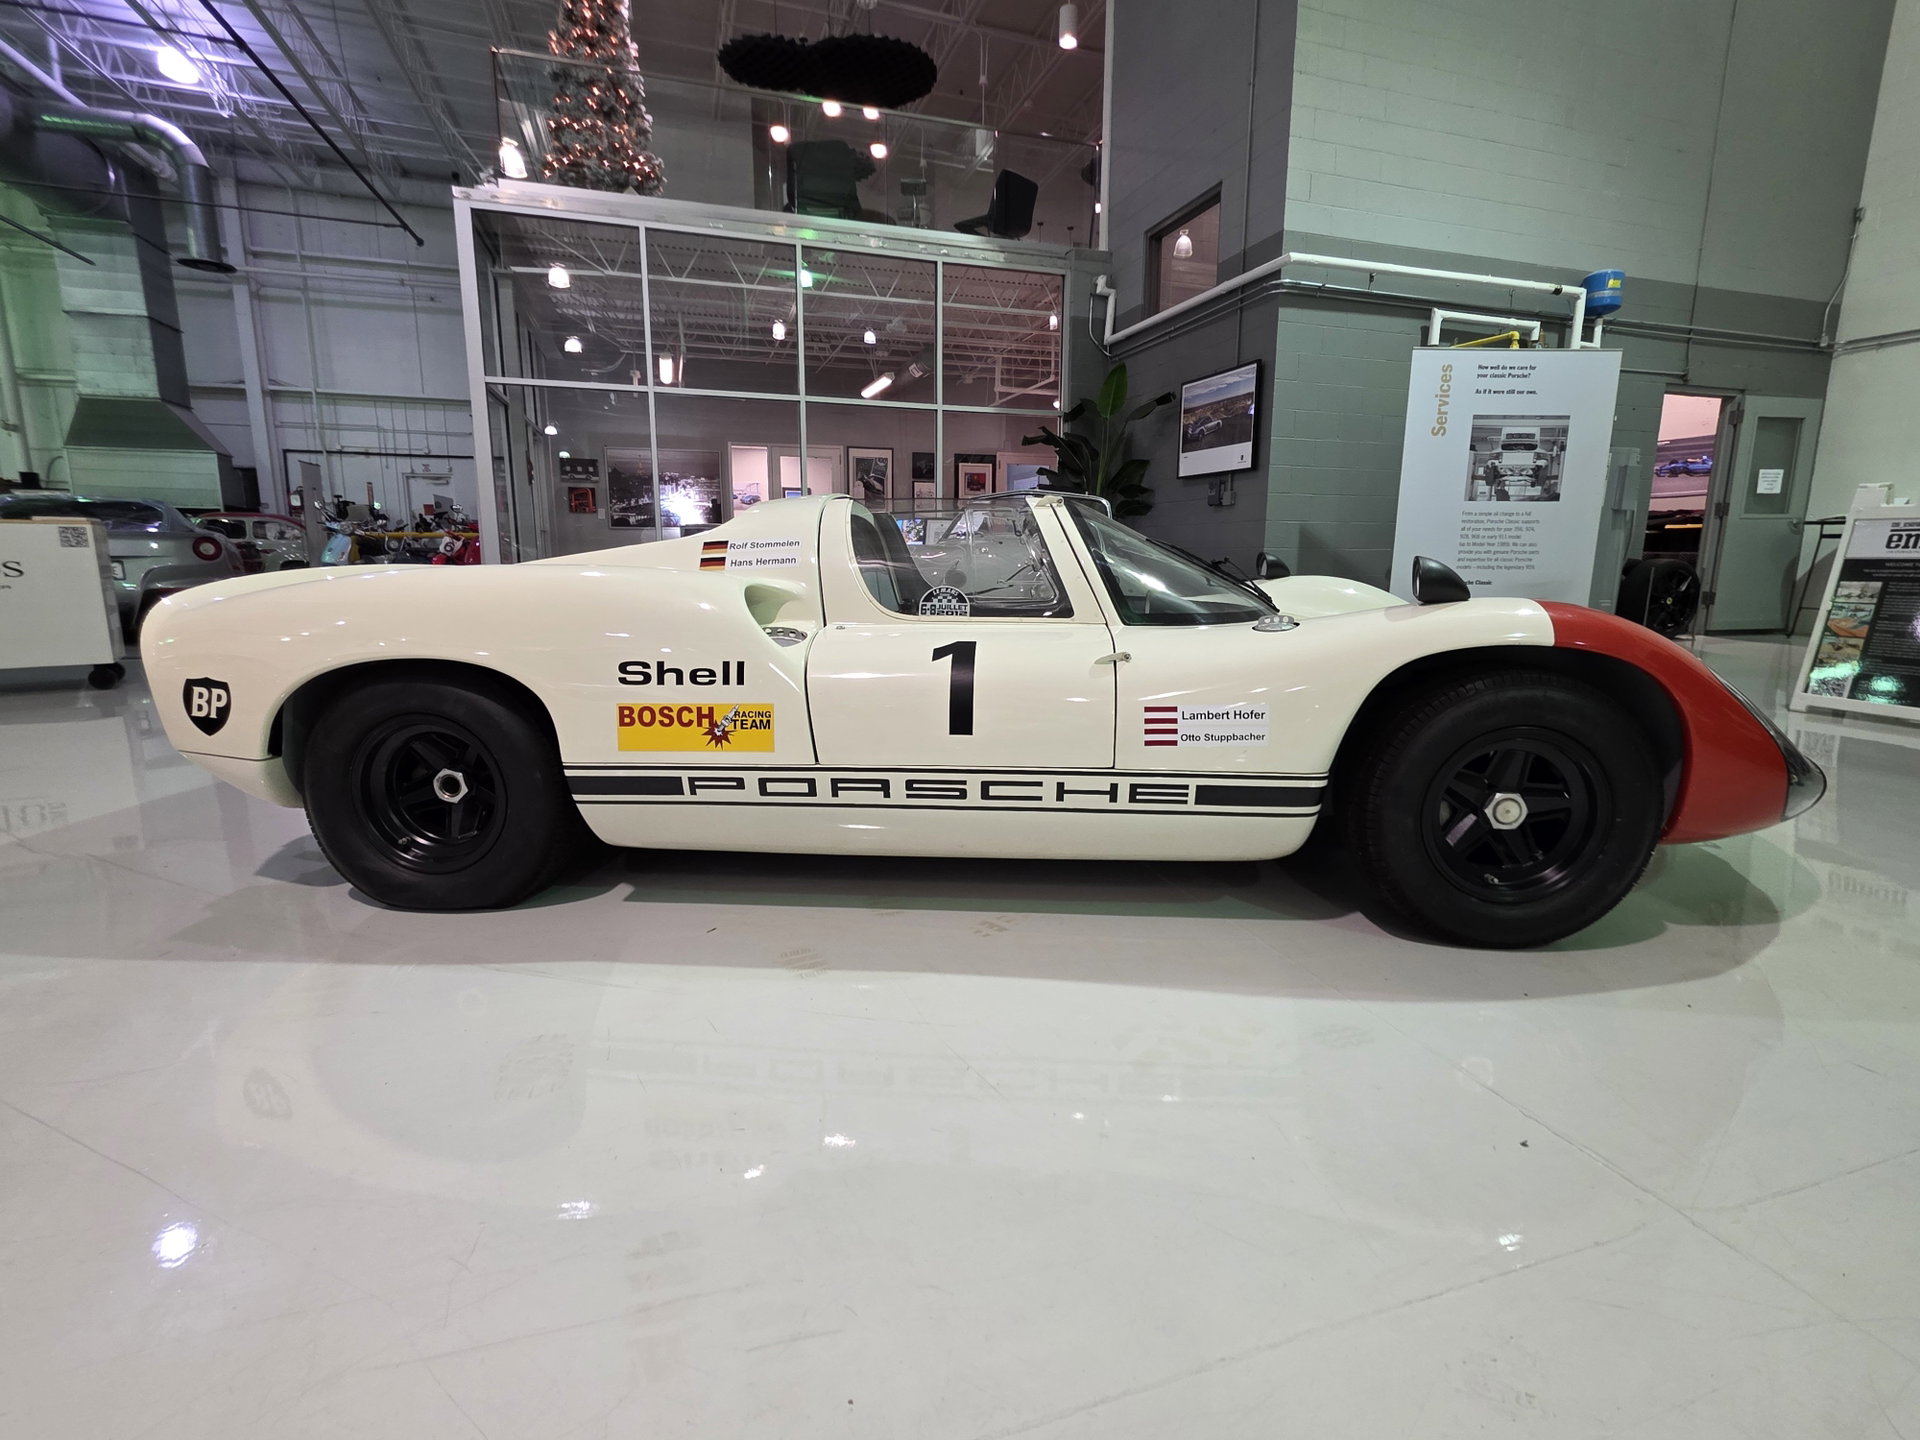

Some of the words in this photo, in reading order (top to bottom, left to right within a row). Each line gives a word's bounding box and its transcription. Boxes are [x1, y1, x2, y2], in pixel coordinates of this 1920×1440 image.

[1431, 364, 1453, 437] Services
[750, 540, 800, 549] Stommelen
[756, 557, 796, 566] Hermann
[940, 588, 959, 596] MANS
[618, 661, 745, 686] Shell
[932, 641, 976, 735] 1
[191, 686, 228, 718] BP
[618, 706, 714, 728] BOSCH
[1182, 711, 1230, 720] Lambert
[1234, 710, 1266, 720] Hofer
[732, 720, 770, 730] TEAM
[1204, 733, 1266, 742] Stuppbacher
[688, 777, 1190, 804] PORSCHE
